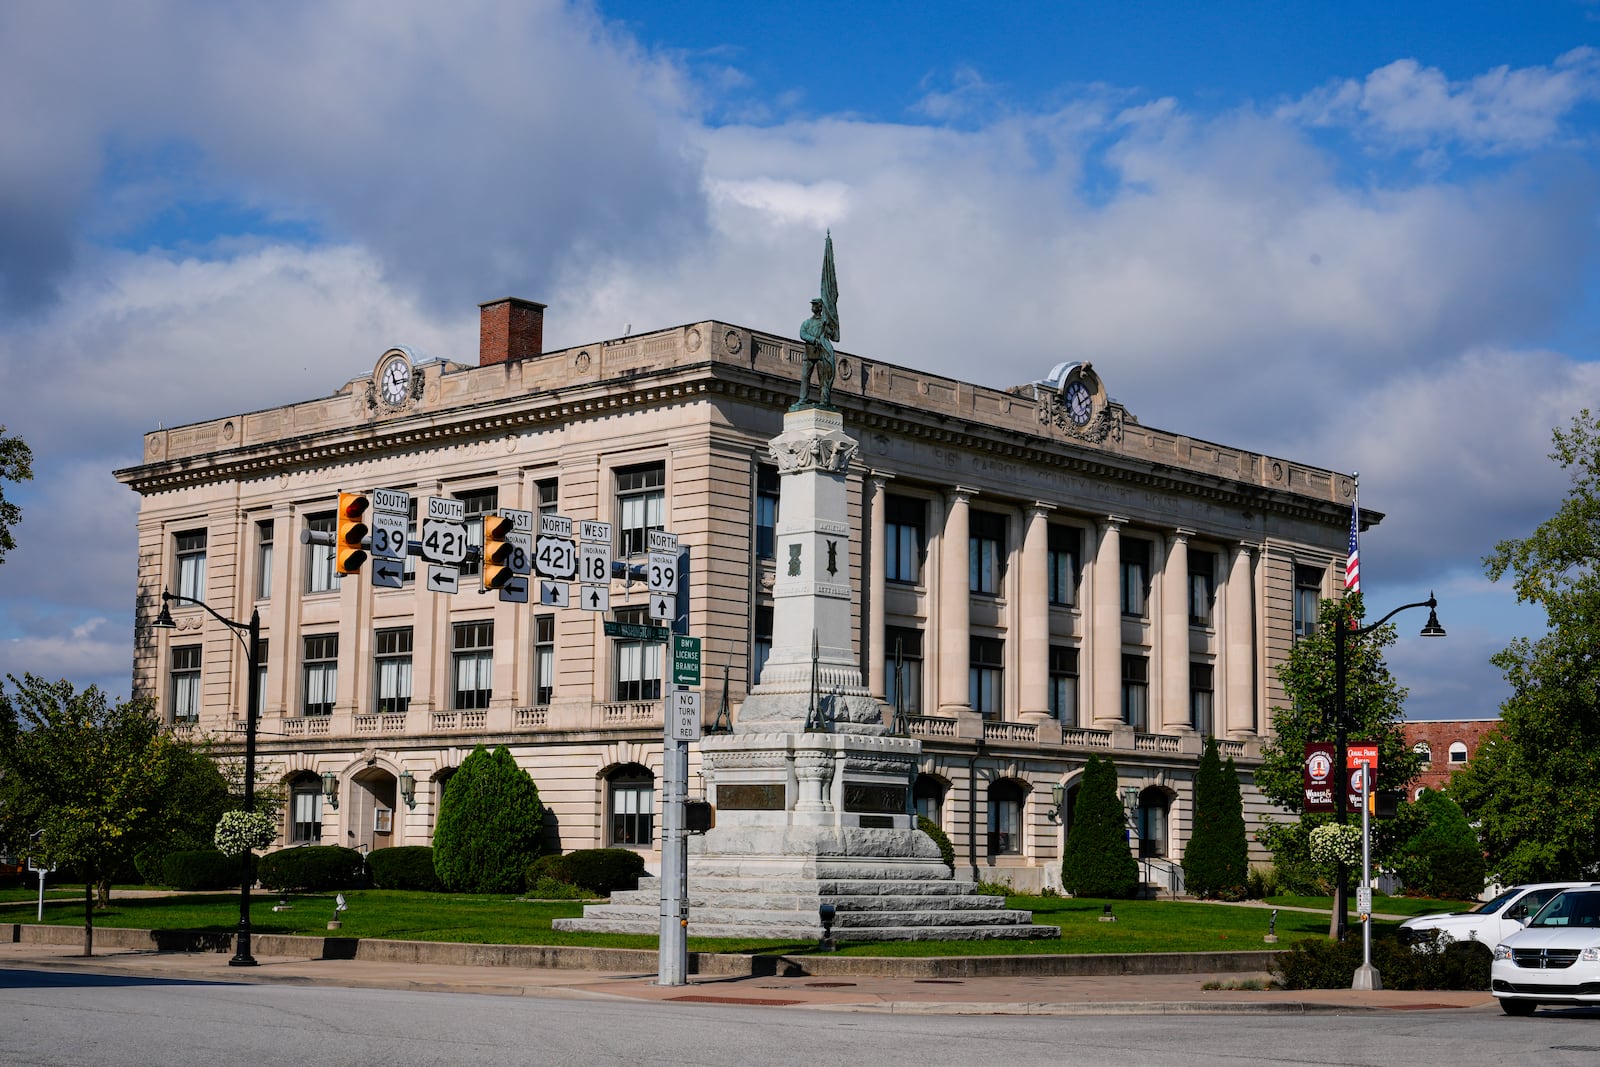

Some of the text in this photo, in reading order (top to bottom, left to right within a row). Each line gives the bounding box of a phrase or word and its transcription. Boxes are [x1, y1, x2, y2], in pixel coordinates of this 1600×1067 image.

[375, 491, 407, 509] SOUTH
[430, 500, 462, 517] SOUTH
[377, 517, 403, 527] INDIANA
[542, 517, 571, 534] NORTH
[584, 523, 609, 539] WEST
[375, 528, 404, 553] 39
[425, 530, 463, 557] 421
[505, 535, 527, 545] NDIANA
[650, 533, 677, 549] NORTH
[583, 547, 607, 555] INDIANA
[539, 545, 571, 570] 421
[653, 556, 673, 565] INDIANA
[585, 556, 605, 579] 18
[651, 565, 674, 588] 39
[681, 639, 694, 648] BMV
[675, 650, 699, 660] LICENSE
[675, 662, 699, 672] BRANCH
[680, 695, 694, 705] NO
[679, 707, 696, 716] TURN
[681, 718, 692, 726] ON
[680, 728, 693, 737] RED
